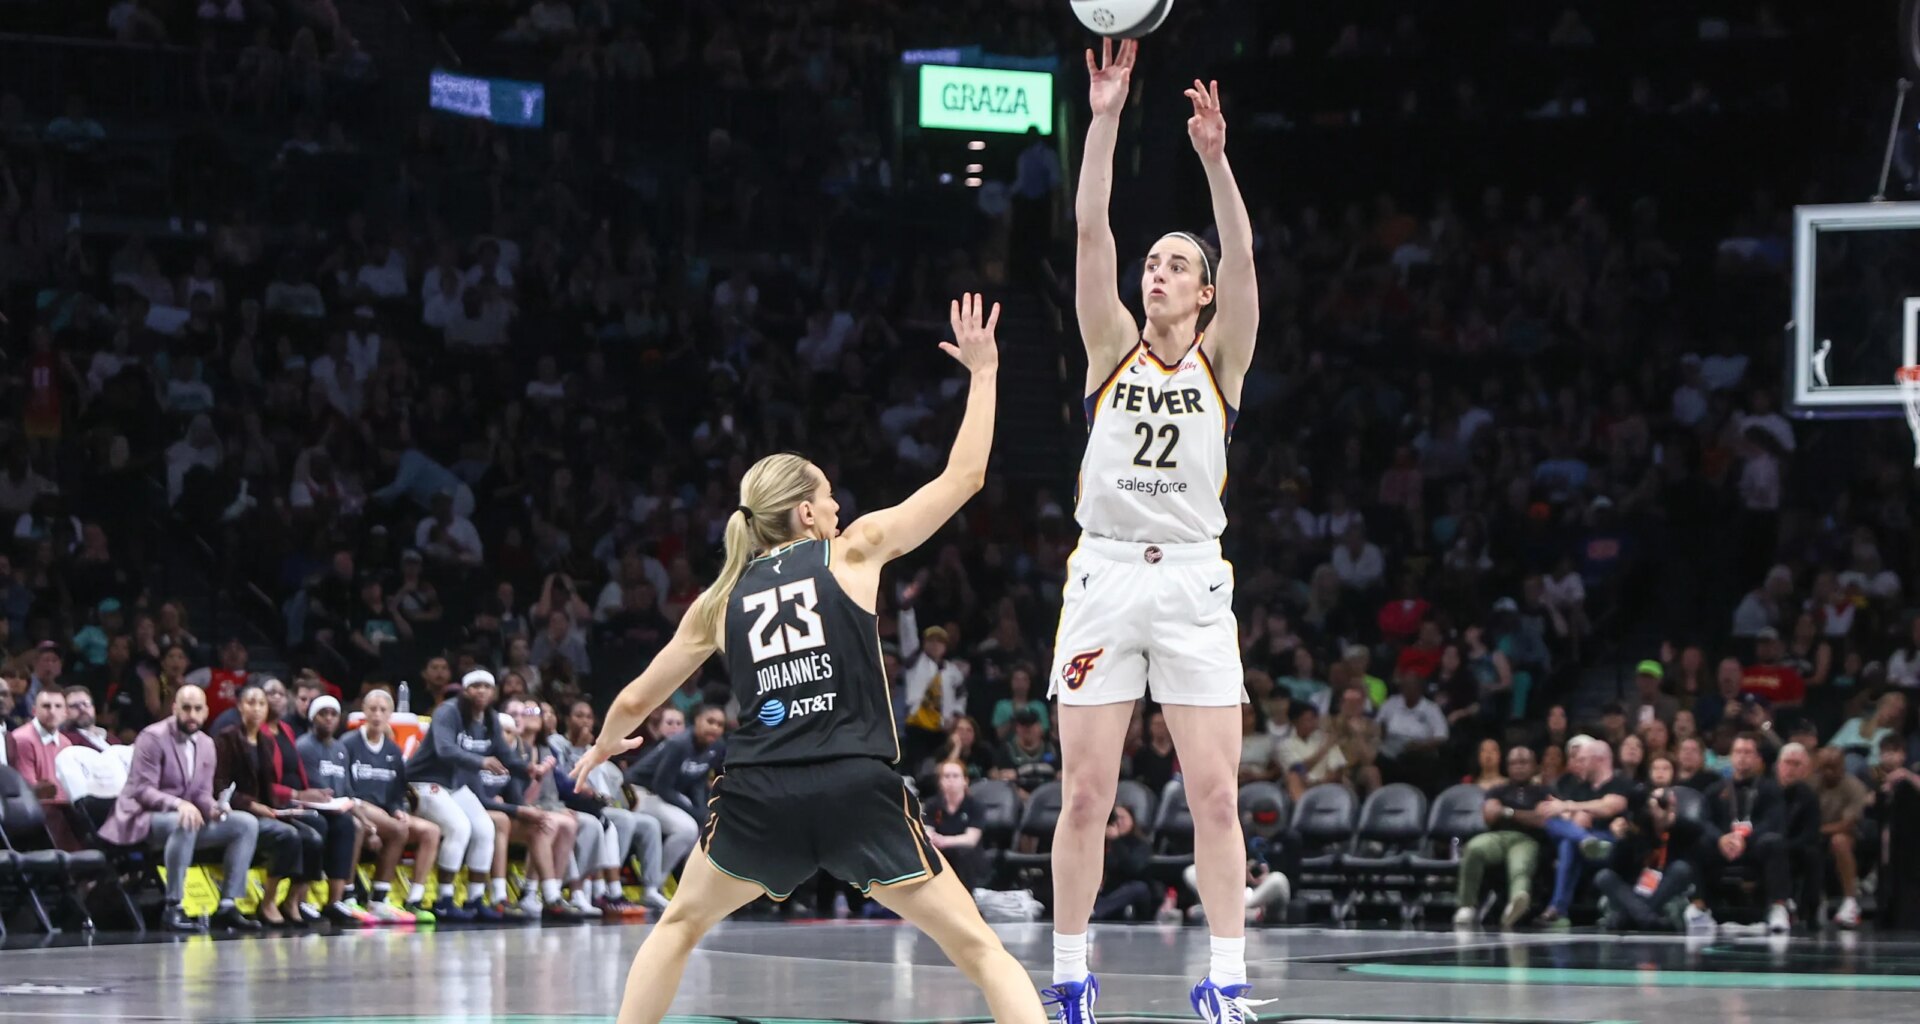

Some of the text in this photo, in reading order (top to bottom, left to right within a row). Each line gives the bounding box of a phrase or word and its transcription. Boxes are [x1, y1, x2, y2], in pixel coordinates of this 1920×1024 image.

[942, 82, 1030, 114] GRAZA
[1112, 383, 1204, 415] FEVER
[1133, 421, 1180, 468] 22
[1117, 477, 1187, 496] salesforce
[742, 577, 826, 663] 23
[756, 651, 833, 696] JOHANNÈS
[788, 692, 837, 719] AT&T
